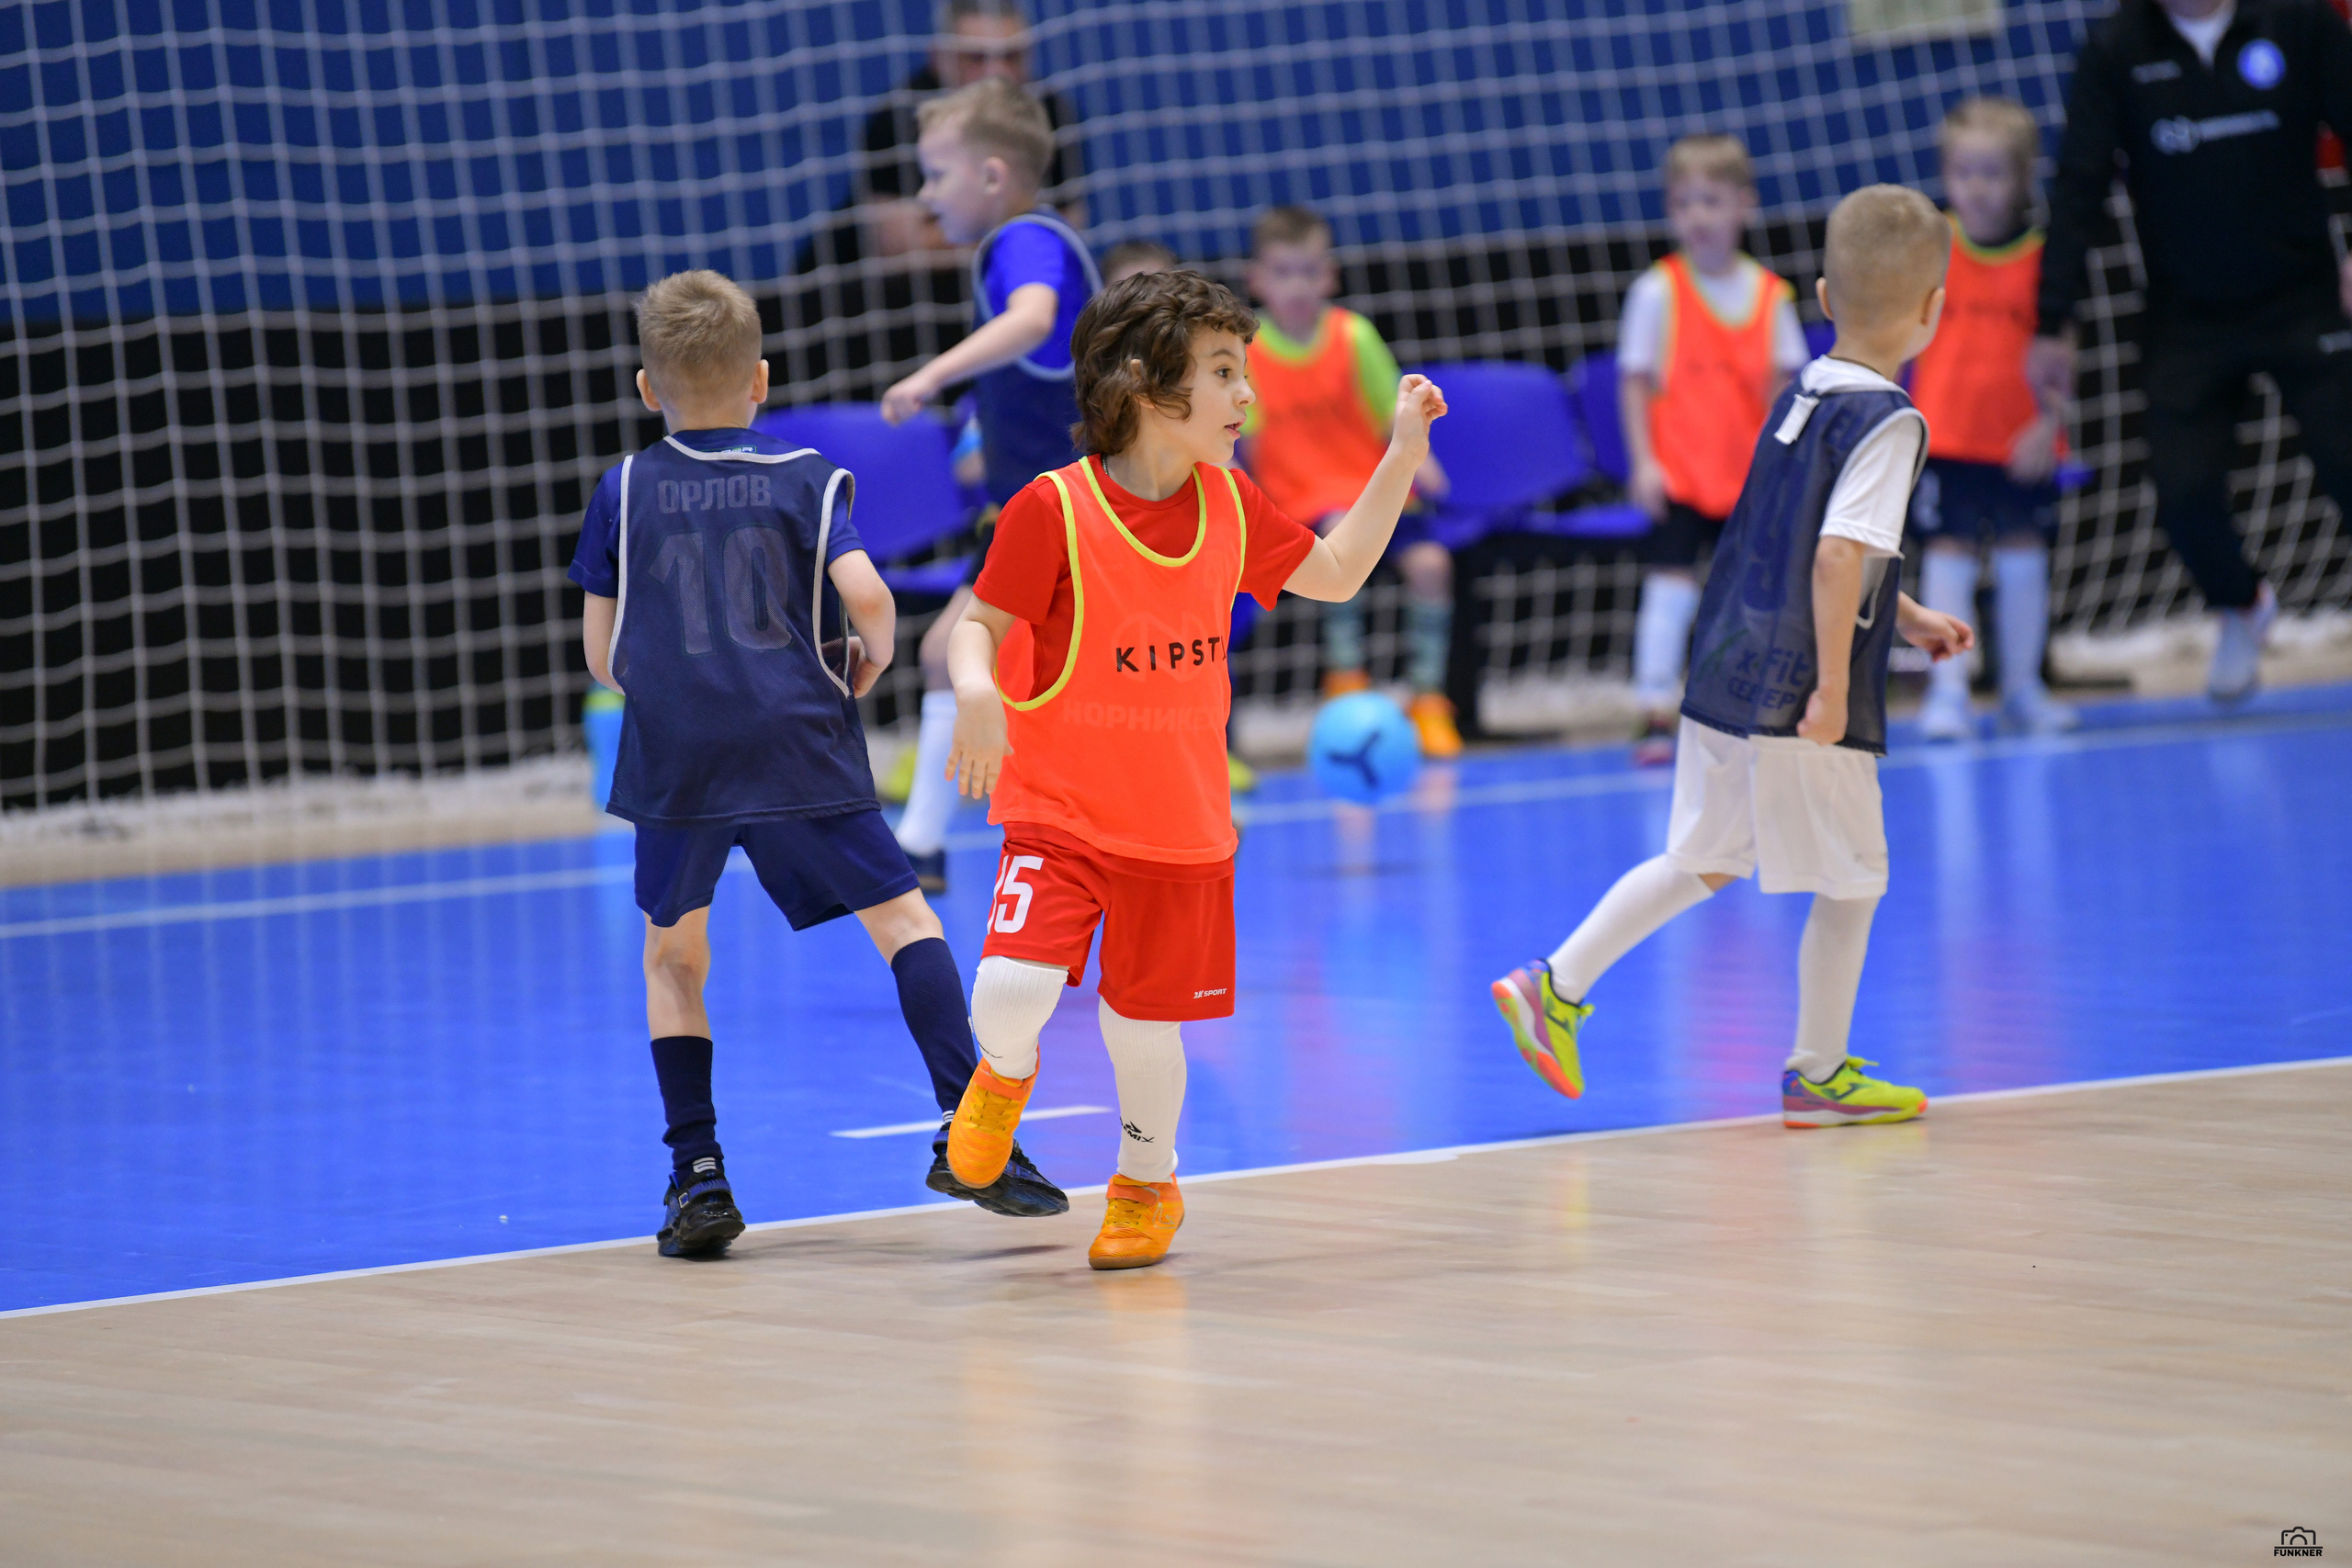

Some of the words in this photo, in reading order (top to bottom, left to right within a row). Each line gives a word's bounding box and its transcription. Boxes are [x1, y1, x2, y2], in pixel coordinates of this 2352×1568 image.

[657, 474, 772, 514] ОРЛОВ
[647, 525, 793, 656] 10
[1115, 636, 1227, 672] KIPST
[987, 854, 1045, 935] 5
[1204, 988, 1227, 997] SPORT
